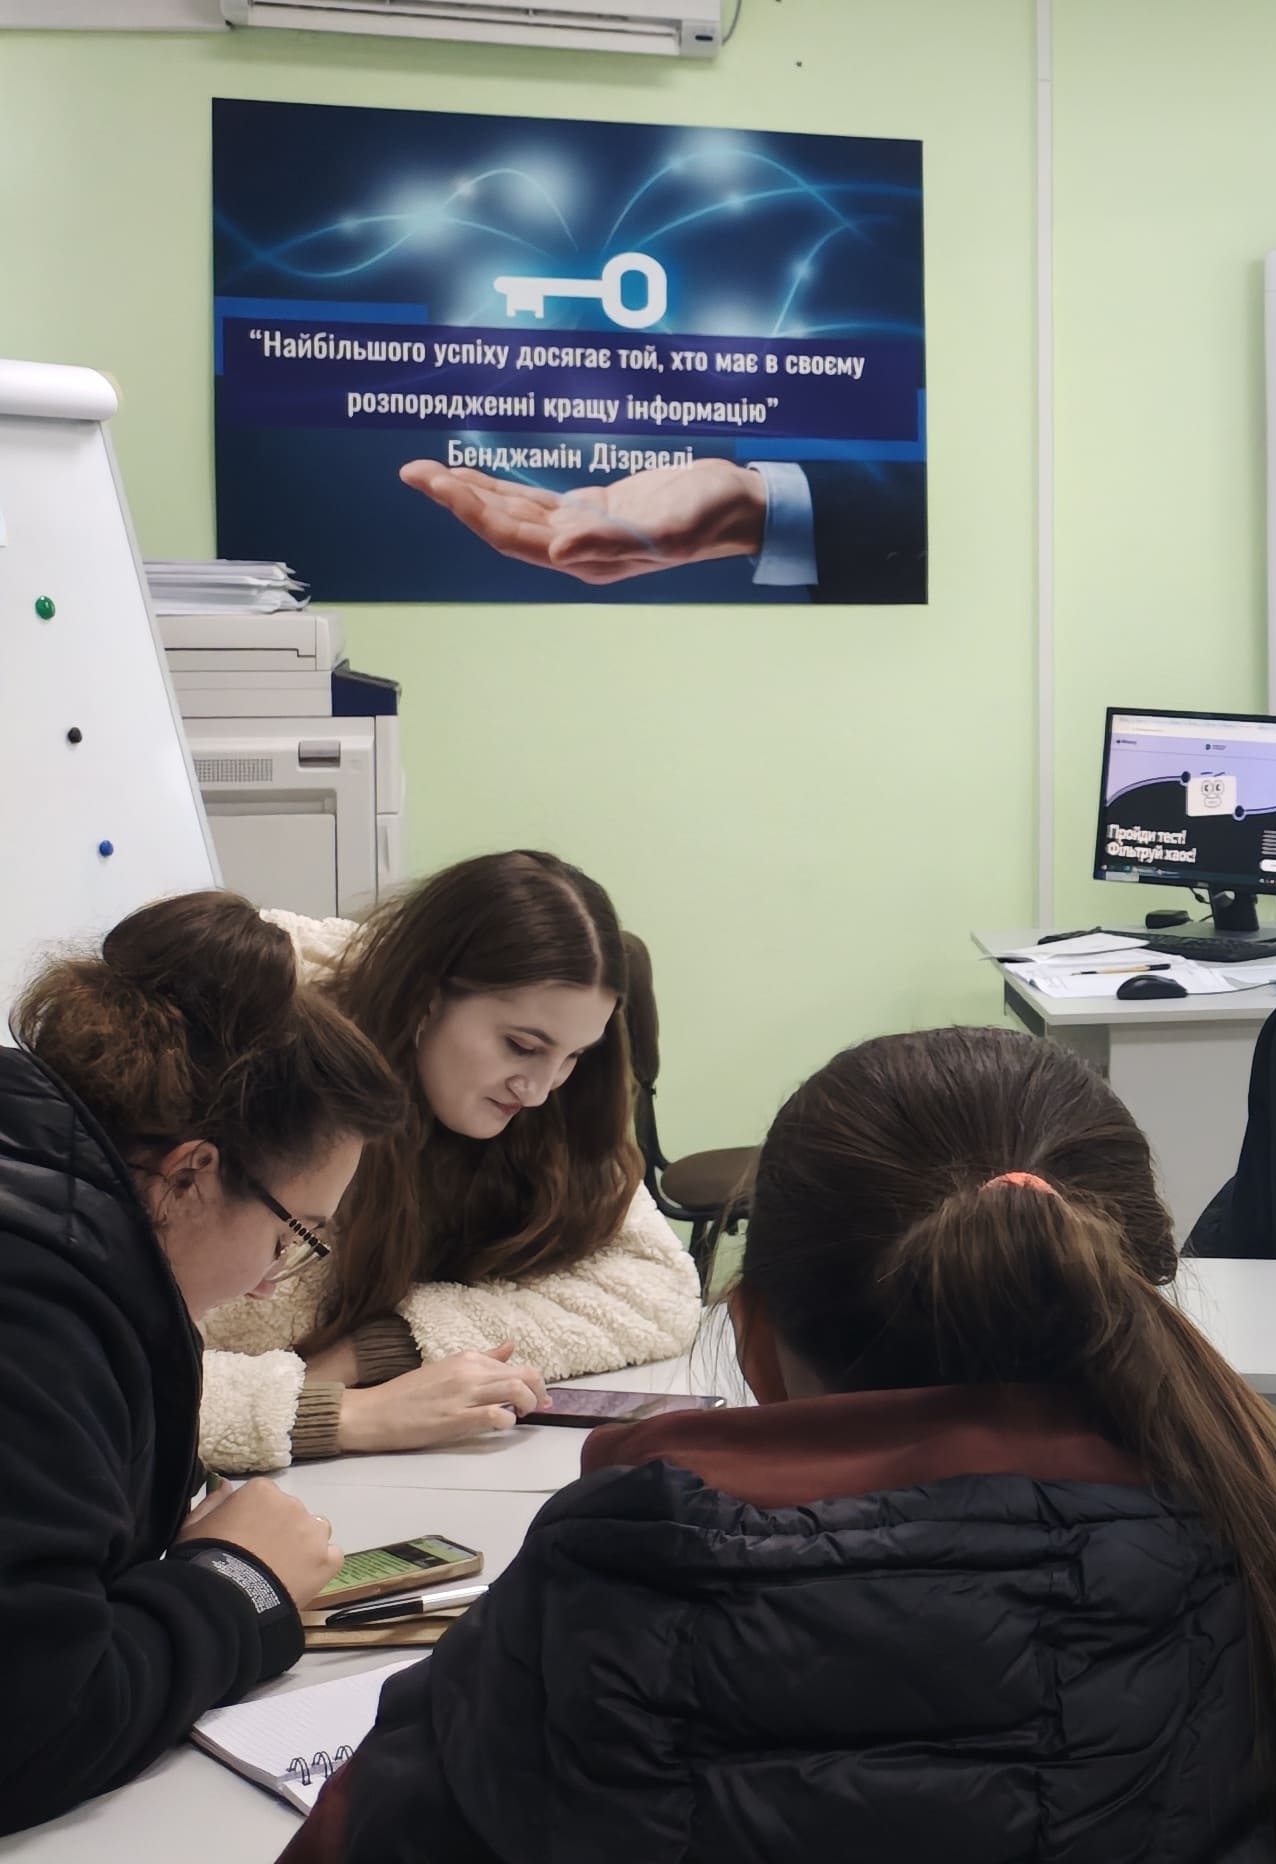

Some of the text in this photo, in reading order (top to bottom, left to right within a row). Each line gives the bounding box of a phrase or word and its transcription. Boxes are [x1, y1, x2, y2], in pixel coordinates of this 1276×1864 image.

[433, 341, 510, 370] успіху
[515, 346, 611, 370] досягає
[617, 345, 664, 373] той,
[670, 351, 708, 372] хто
[715, 352, 758, 373] має
[765, 355, 778, 373] в
[785, 354, 865, 379] своєму
[347, 391, 535, 420] розпорядженні
[543, 398, 620, 423] кращу
[448, 439, 694, 475] Бенджамін Дізраелі
[1106, 823, 1187, 845] Пройди тест!
[1105, 840, 1195, 863] Фільтруй хаос!
